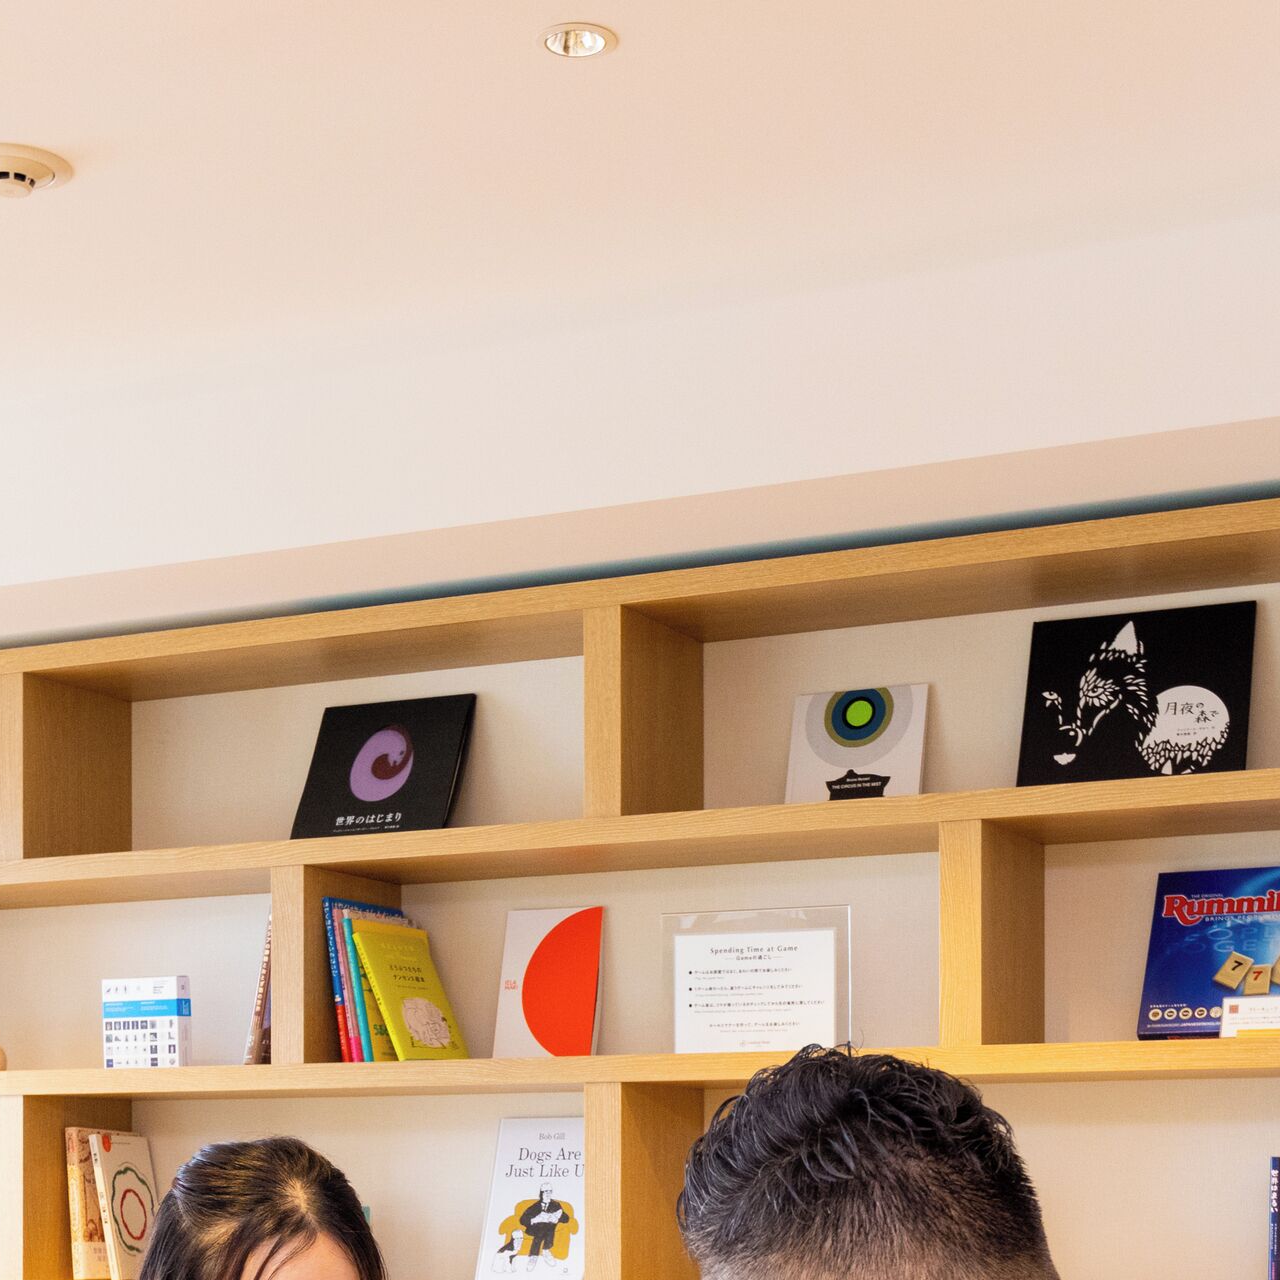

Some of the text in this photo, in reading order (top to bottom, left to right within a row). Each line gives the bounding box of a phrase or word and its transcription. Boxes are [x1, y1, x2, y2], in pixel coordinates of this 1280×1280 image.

[335, 812, 402, 826] 世界のはじまり
[710, 947, 744, 955] Spending
[1231, 960, 1243, 971] 7
[1252, 970, 1263, 981] 7
[539, 1132, 566, 1141] Bob Gill
[518, 1147, 581, 1164] Dogs Are
[505, 1164, 534, 1178] Just
[539, 1164, 569, 1178] Like
